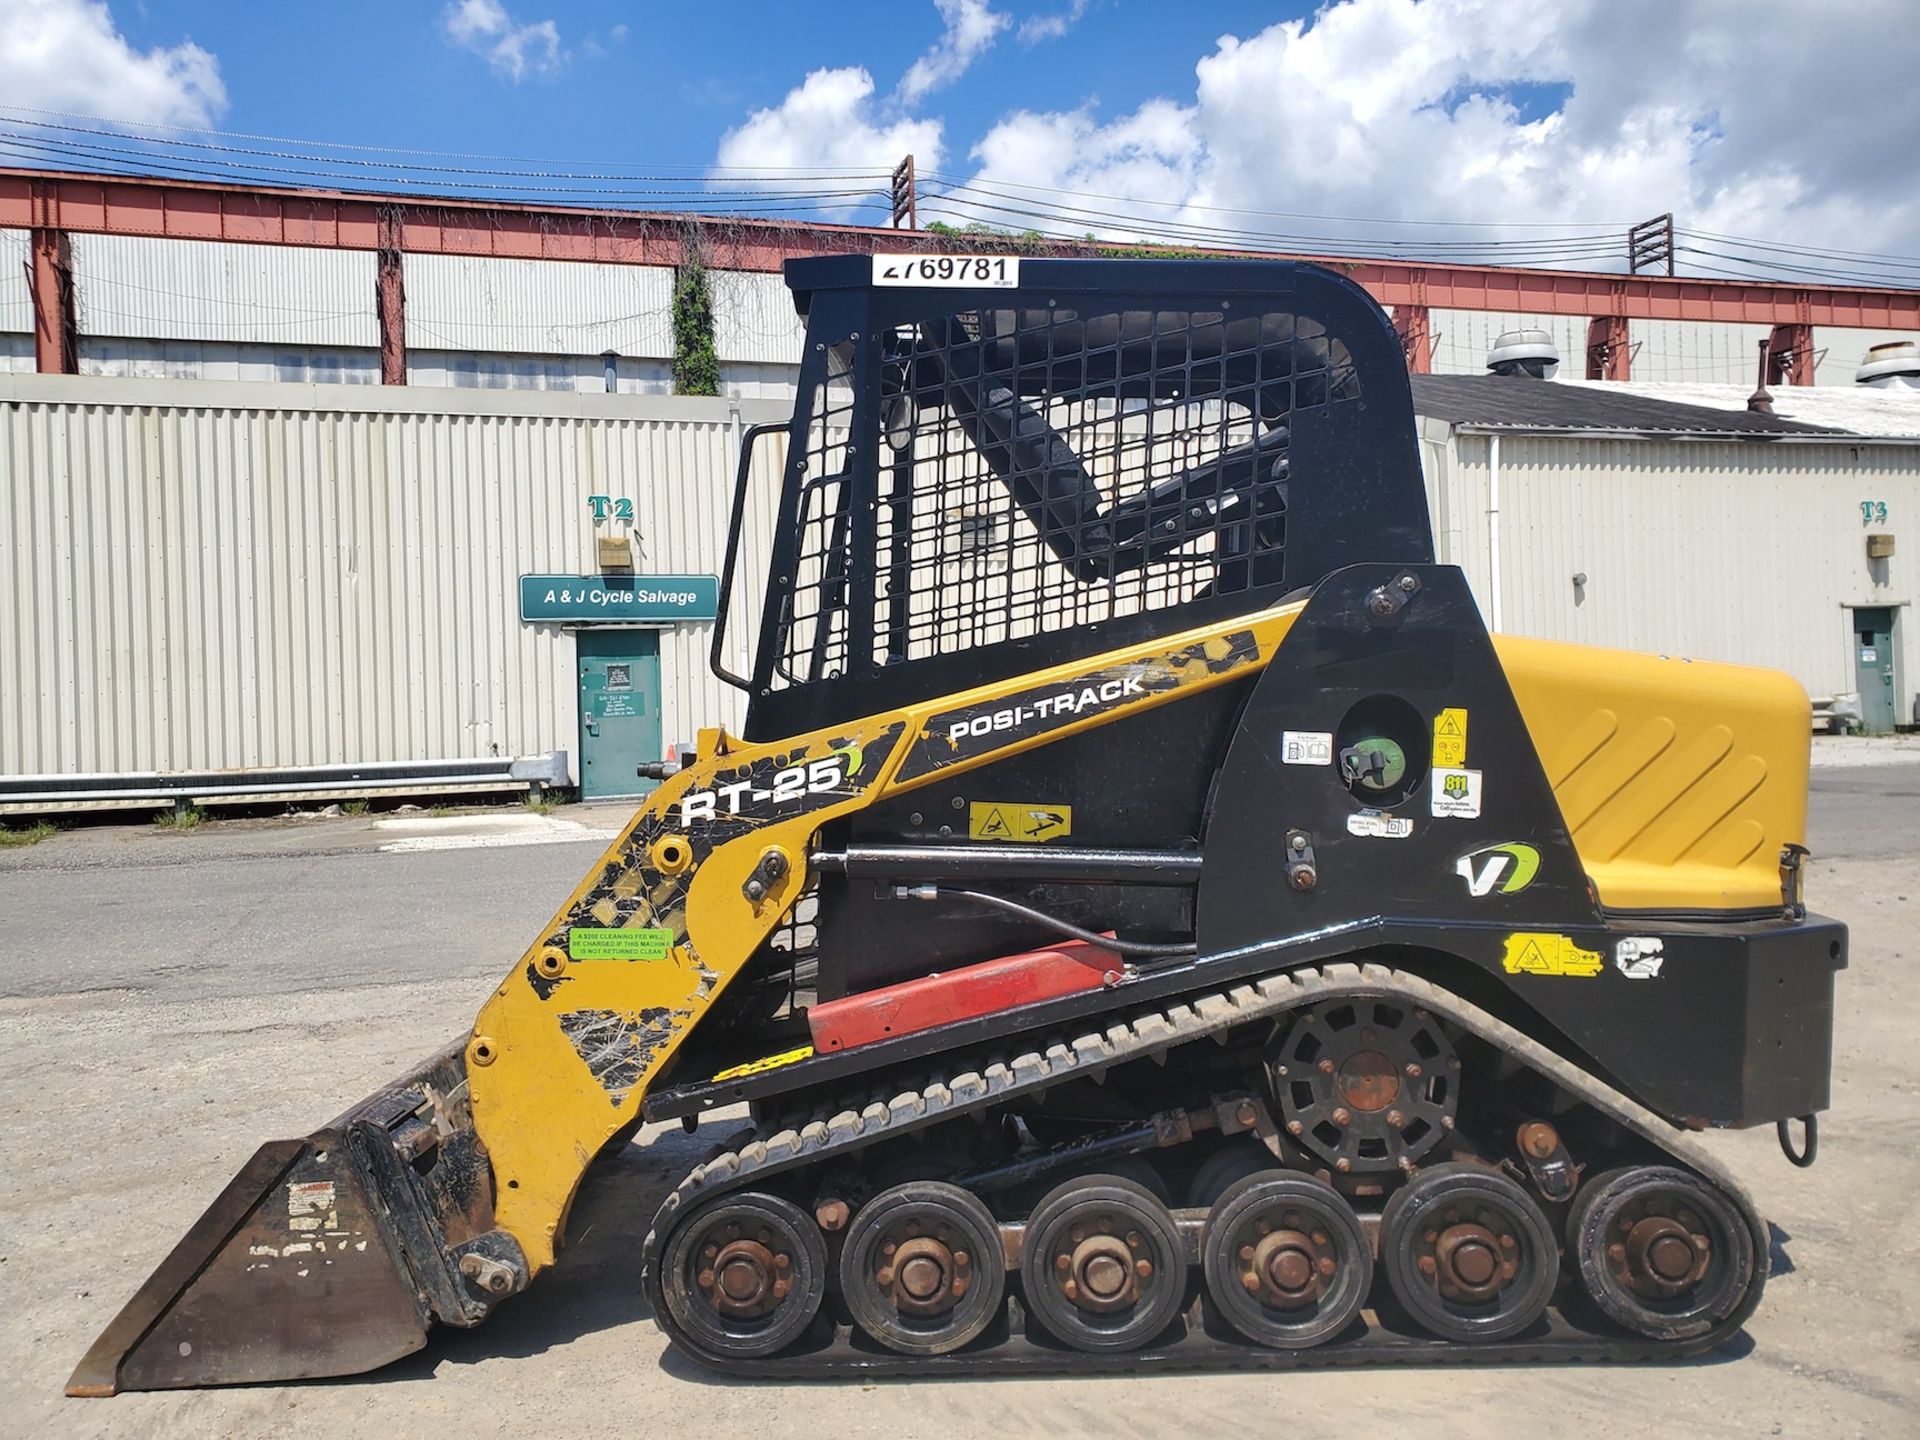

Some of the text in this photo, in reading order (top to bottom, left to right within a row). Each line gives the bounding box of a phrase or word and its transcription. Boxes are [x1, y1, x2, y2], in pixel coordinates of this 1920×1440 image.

[544, 589, 697, 606] A & J Cycle Salvage
[949, 674, 1145, 742] POSI-TRACK
[681, 756, 842, 828] RT-25
[1445, 774, 1468, 791] 811
